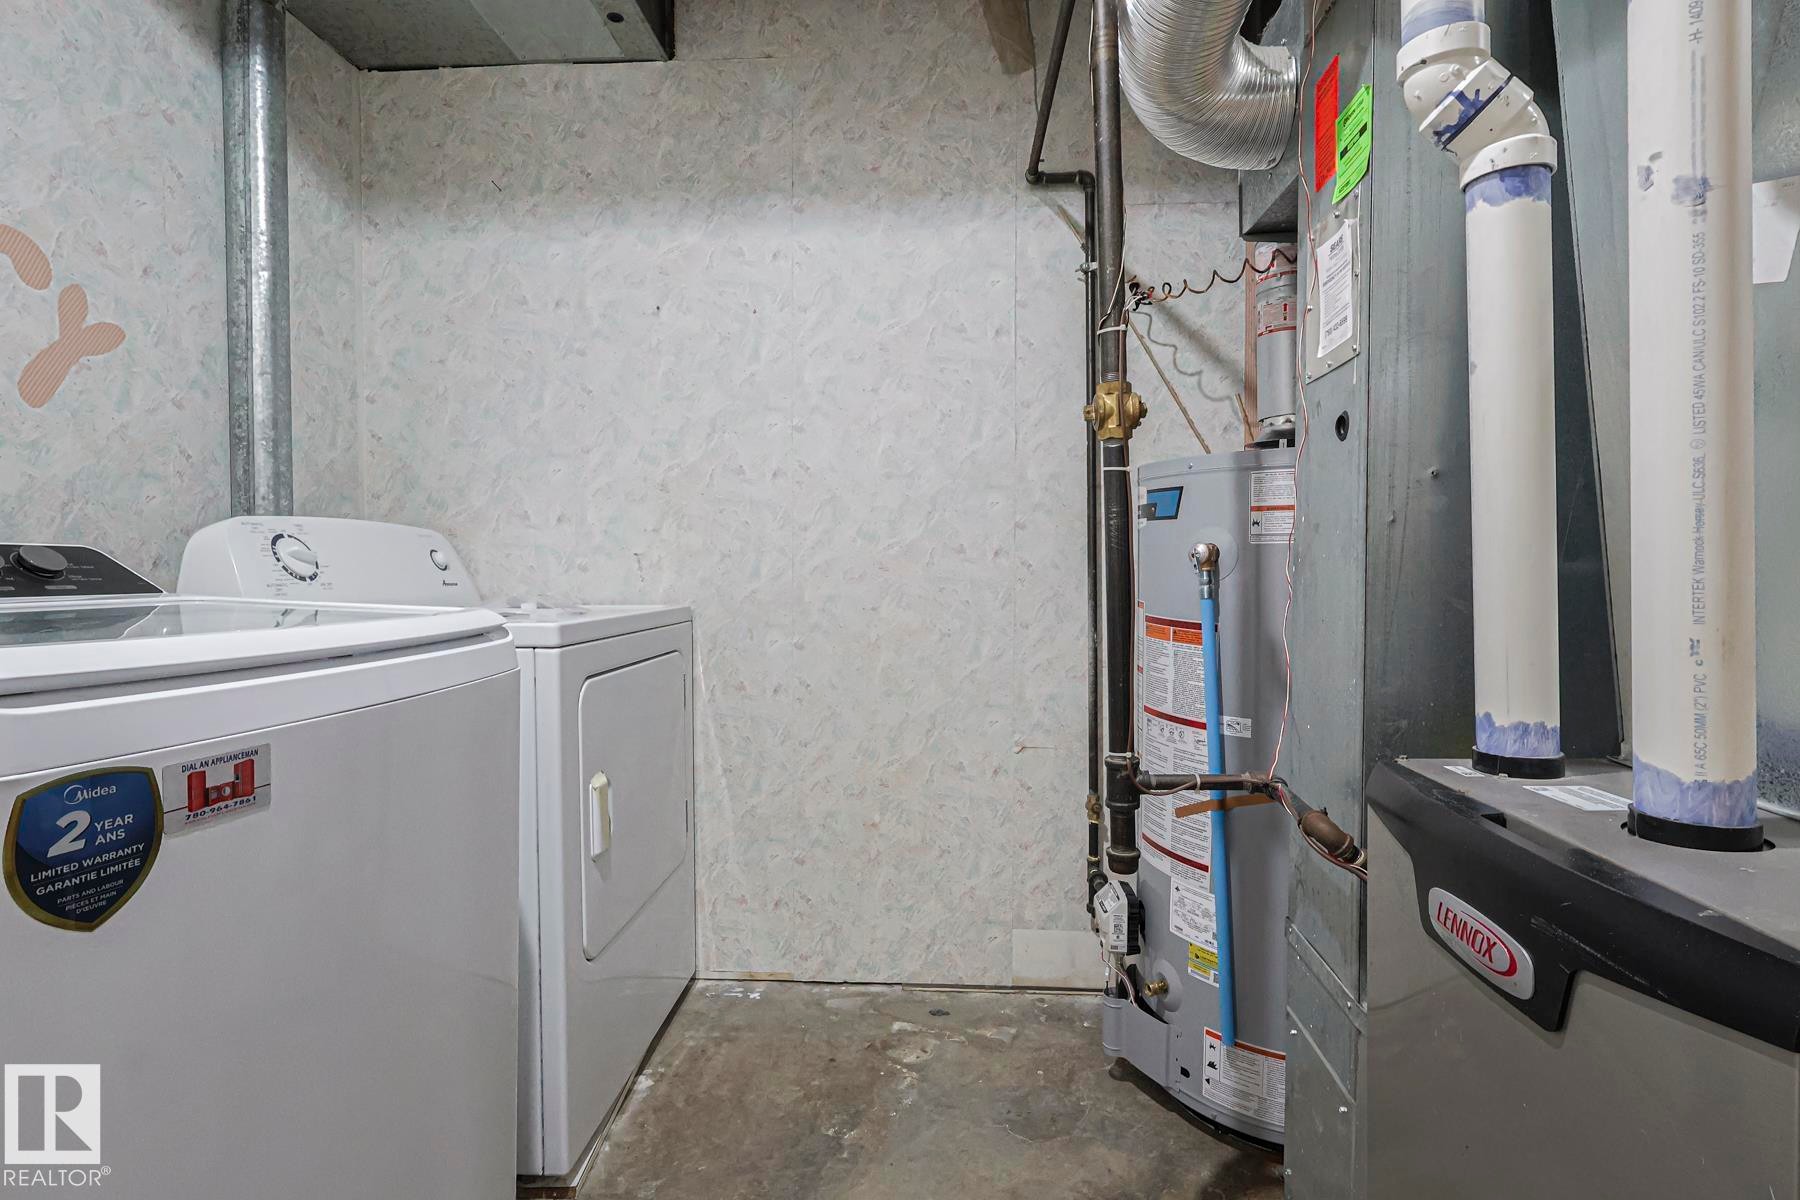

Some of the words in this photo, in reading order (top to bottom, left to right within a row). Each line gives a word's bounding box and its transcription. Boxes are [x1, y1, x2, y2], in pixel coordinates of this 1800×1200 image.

[1692, 402, 1706, 435] LISTED
[1692, 577, 1705, 625] INTERTEK
[1693, 673, 1707, 694] PVC
[1693, 714, 1707, 740] 50MM
[181, 763, 197, 773] DIAL
[199, 759, 209, 769] AN
[210, 748, 259, 767] APPLIANCEMAN
[1693, 742, 1707, 761] 65C
[64, 784, 117, 805] Midea
[47, 810, 91, 858] 2
[94, 814, 134, 832] YEAR
[95, 828, 126, 846] ANS
[30, 862, 79, 882] LIMITED
[82, 843, 145, 867] WARRANTY
[36, 870, 98, 896] GARANTIE
[100, 857, 141, 876] LIMITÉE
[57, 892, 80, 904] PARTS
[81, 887, 97, 898] AND
[97, 879, 124, 892] LABOUR
[90, 896, 98, 906] ET
[99, 890, 117, 903] MAIN
[1437, 901, 1497, 964] LENNOX
